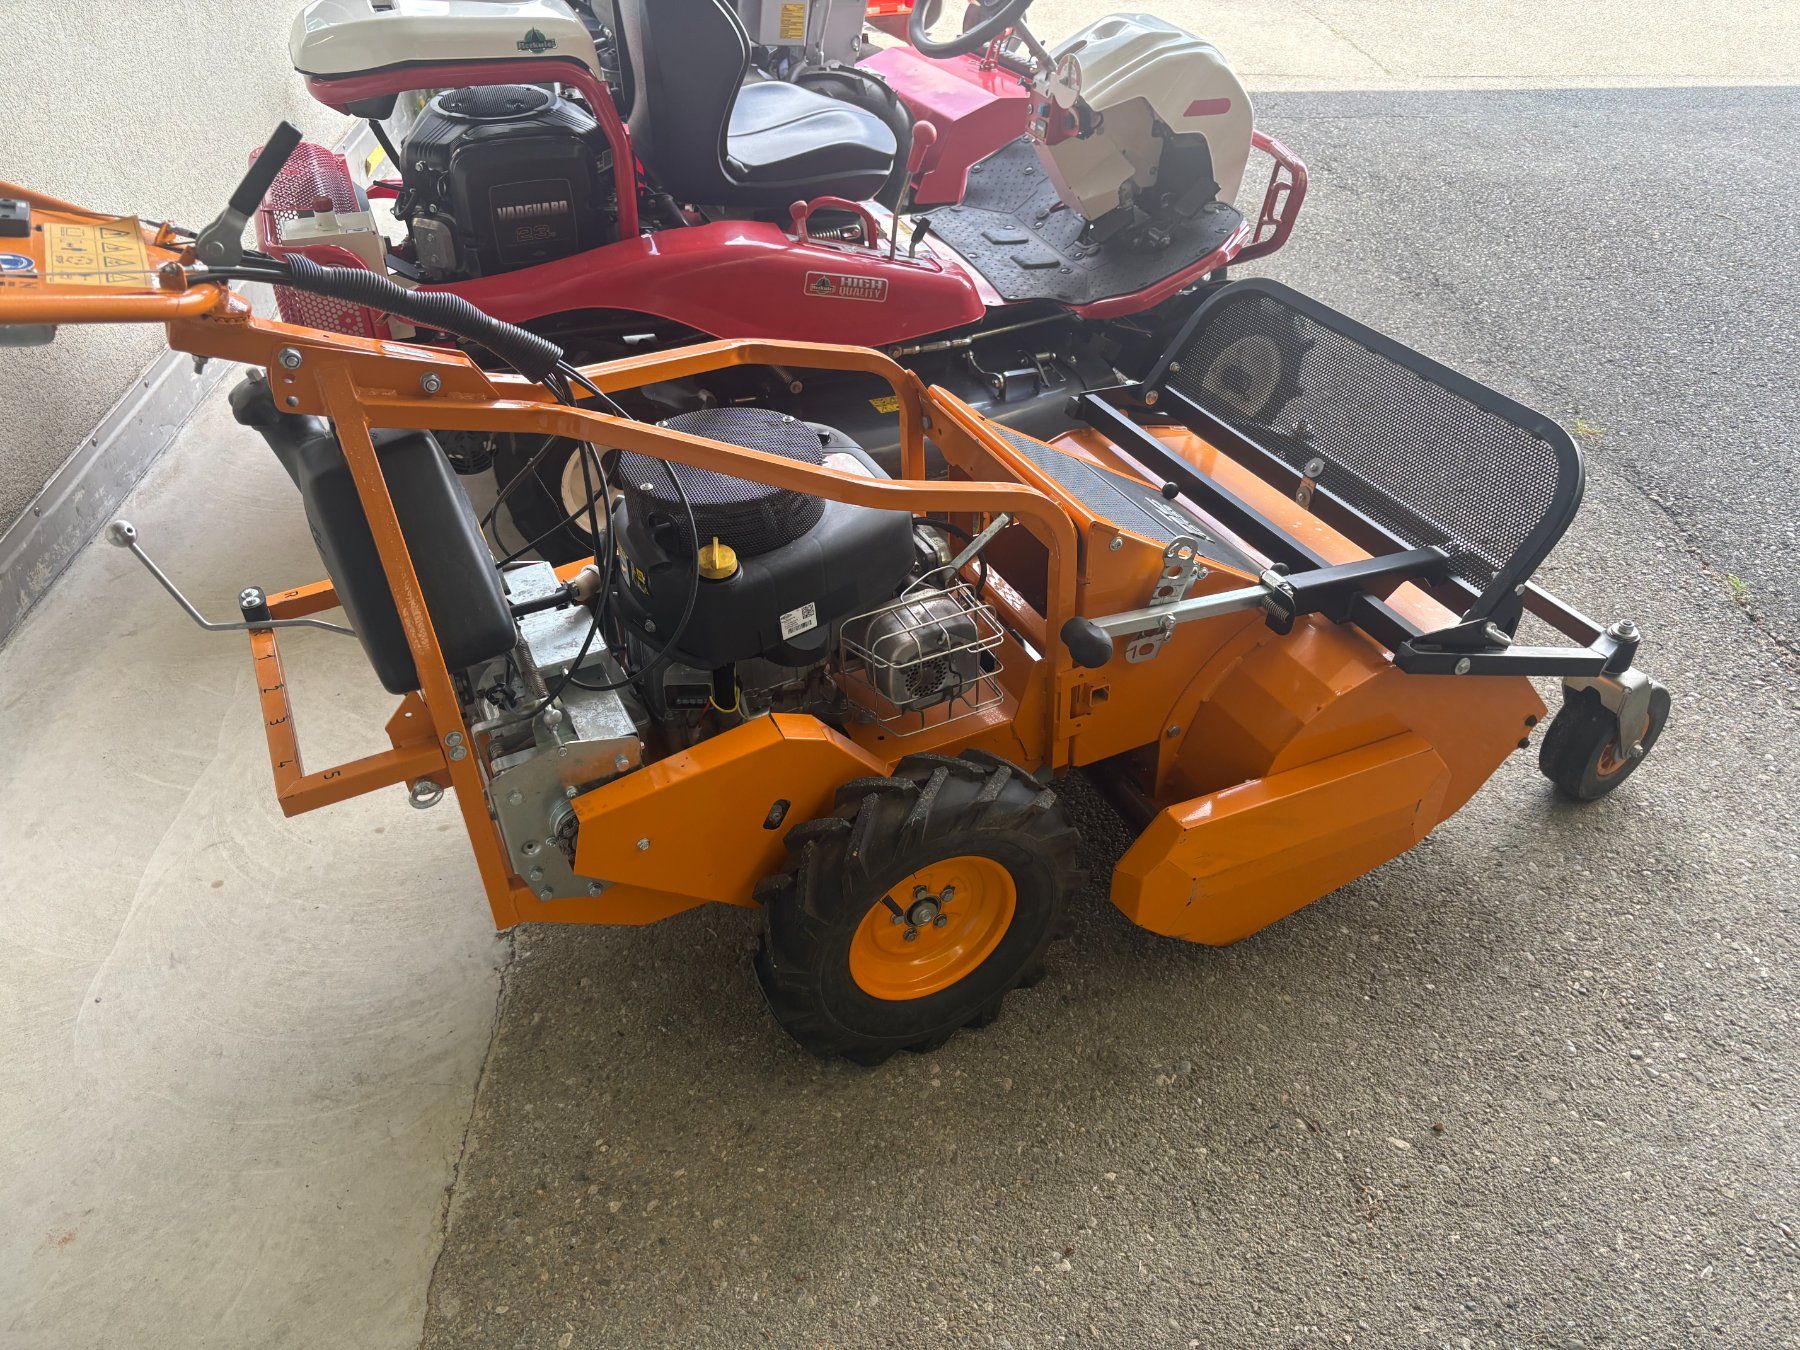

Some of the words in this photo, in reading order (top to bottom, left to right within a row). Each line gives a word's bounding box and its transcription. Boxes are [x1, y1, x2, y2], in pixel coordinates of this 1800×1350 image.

[497, 200, 569, 219] VANGUARD
[840, 277, 883, 289] HIGH
[839, 286, 881, 298] QUALITY
[284, 591, 299, 599] R
[270, 716, 288, 726] 3
[323, 770, 341, 780] 5
